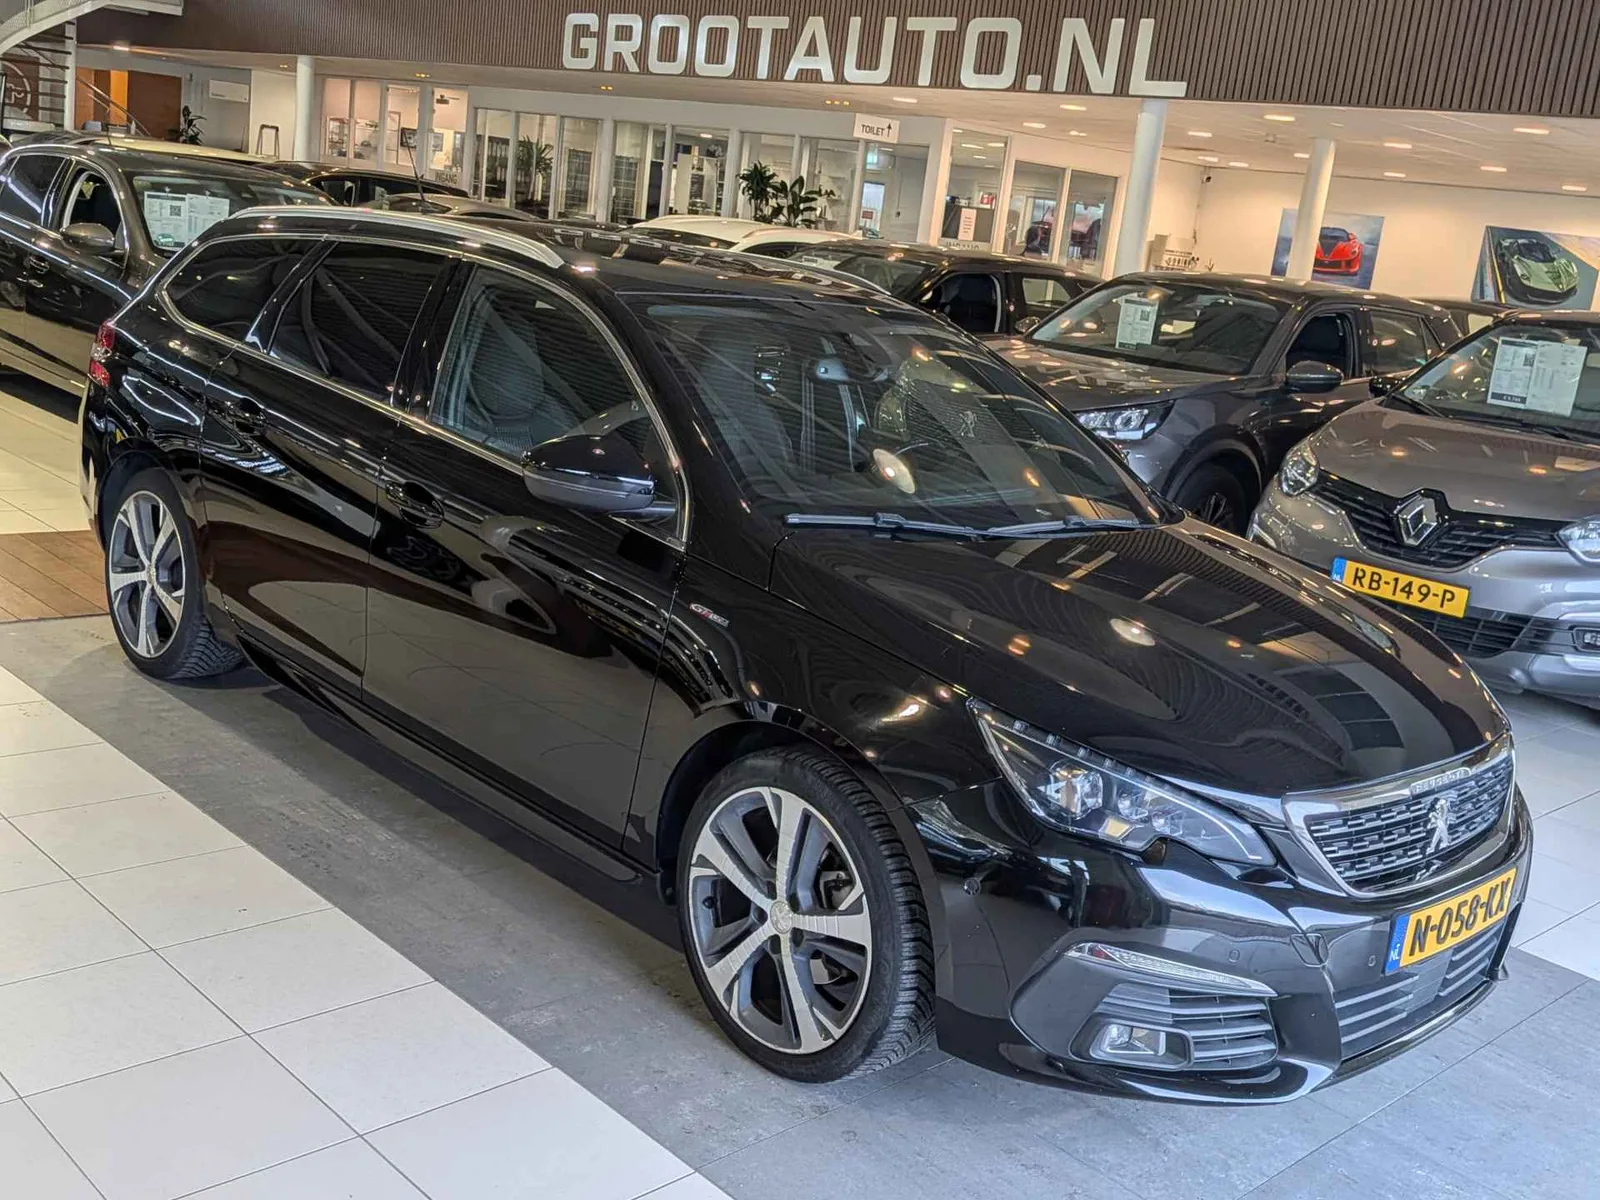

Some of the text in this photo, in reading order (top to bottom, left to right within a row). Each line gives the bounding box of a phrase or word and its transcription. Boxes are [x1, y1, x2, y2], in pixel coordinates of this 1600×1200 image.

[562, 13, 1188, 98] GROOTAUTO.NL
[861, 124, 885, 136] TOILET
[1352, 567, 1456, 608] RB-149-P
[1408, 876, 1512, 957] N-058-KX
[1389, 947, 1400, 962] NL
